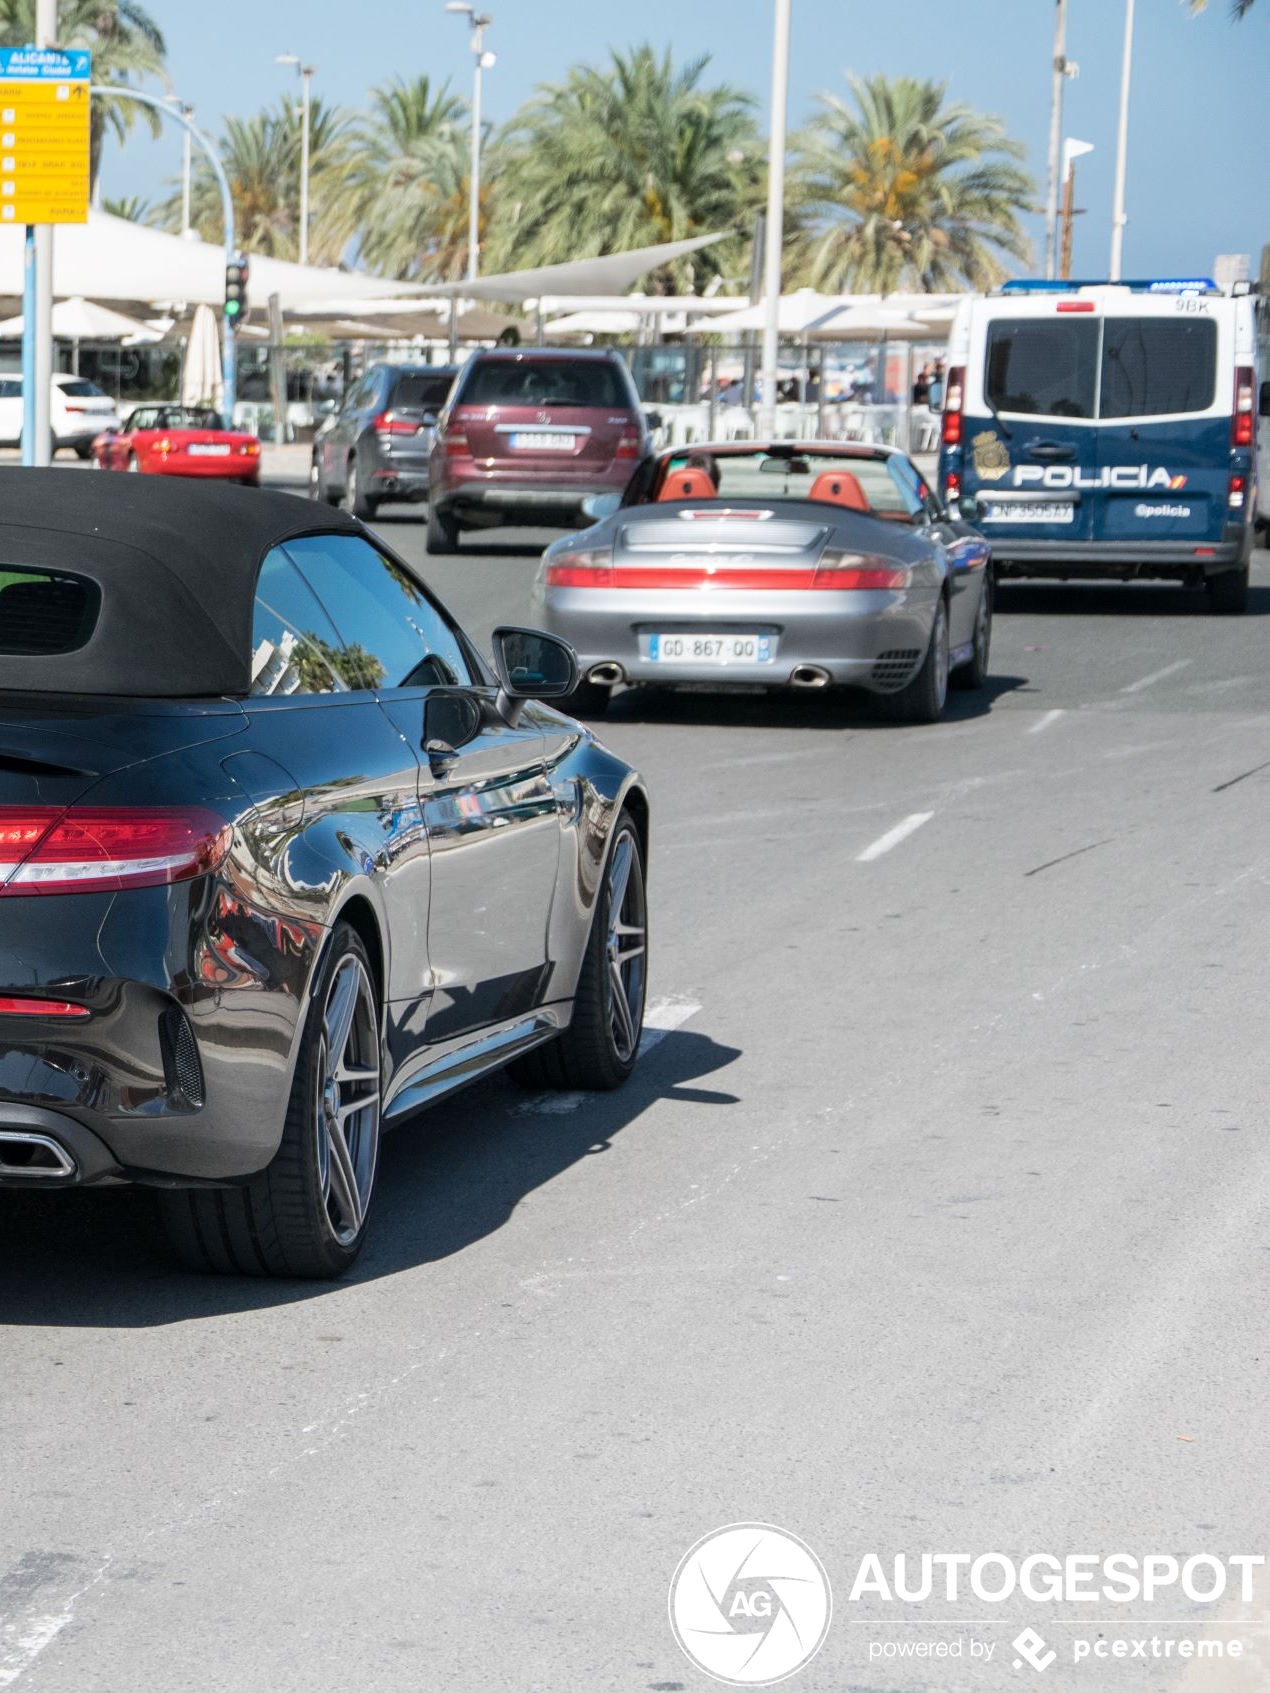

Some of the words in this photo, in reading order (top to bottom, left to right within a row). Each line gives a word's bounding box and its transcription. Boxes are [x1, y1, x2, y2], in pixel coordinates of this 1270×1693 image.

[1176, 299, 1209, 313] 9BK
[1013, 464, 1173, 488] POLICÍA
[1134, 503, 1191, 519] @policia
